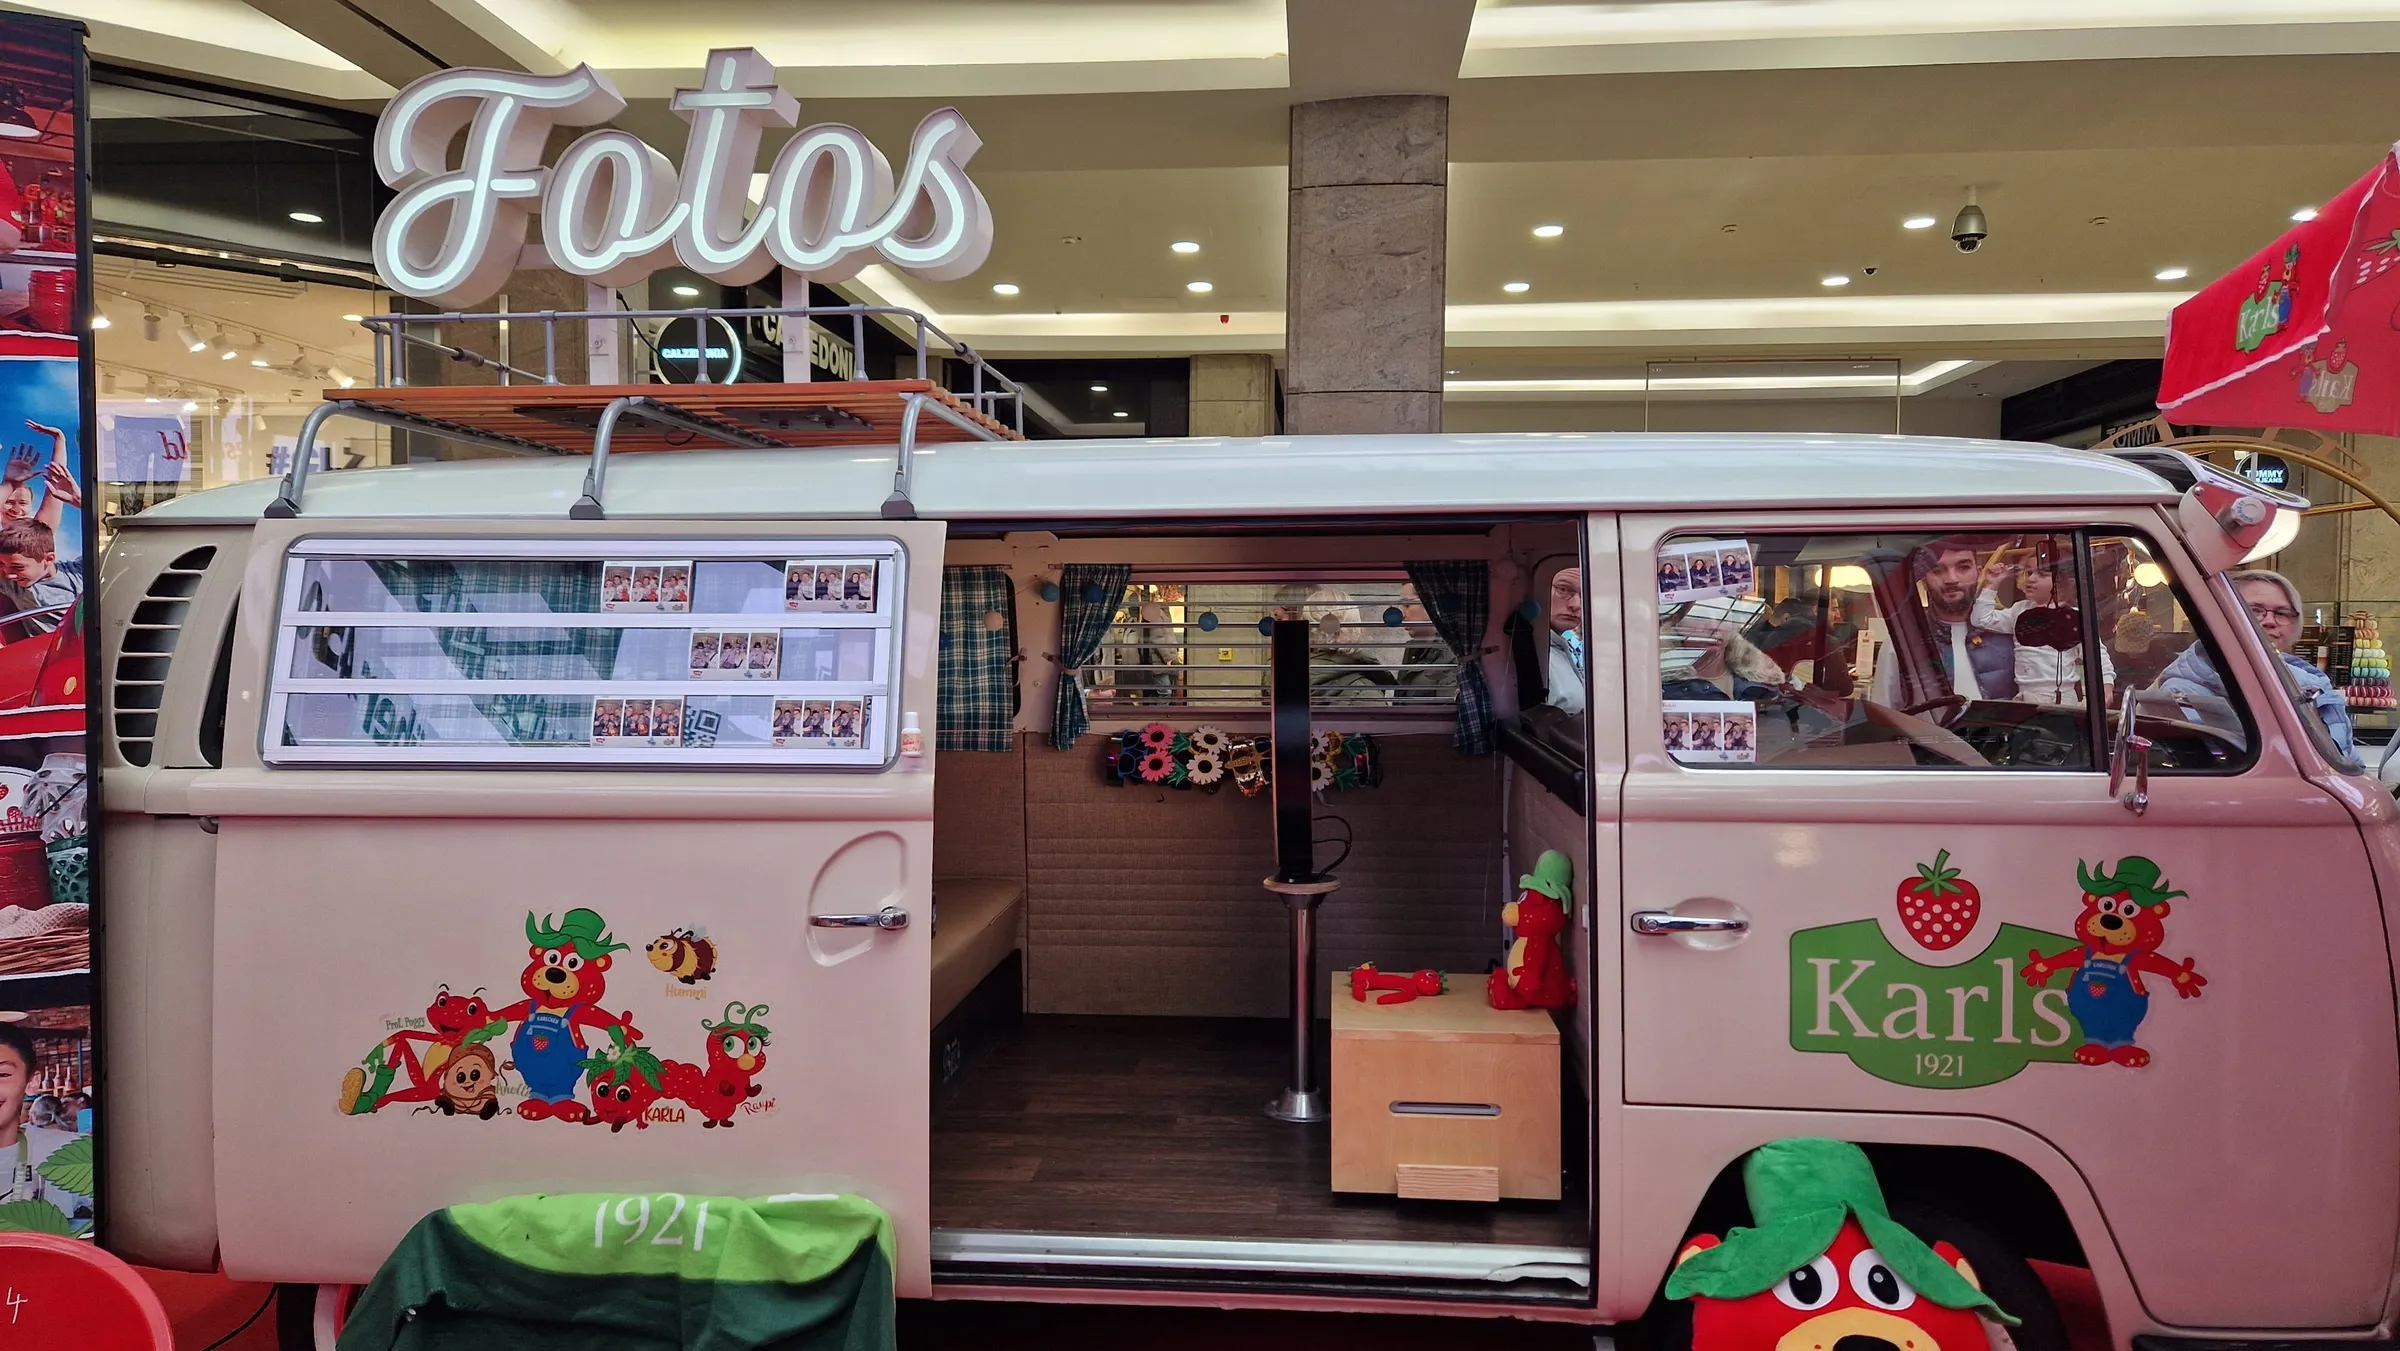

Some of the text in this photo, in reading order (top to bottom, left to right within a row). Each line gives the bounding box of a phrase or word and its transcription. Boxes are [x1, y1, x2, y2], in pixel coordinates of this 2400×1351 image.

[372, 46, 994, 308] Fotos
[2238, 296, 2280, 342] Karls
[762, 305, 858, 382] CAEDONI
[665, 983, 708, 998] Hummi
[1807, 957, 2072, 1047] Karls
[385, 1017, 404, 1031] Prof.
[1915, 1053, 1964, 1077] 1921
[644, 1107, 685, 1123] KARLA
[741, 1097, 777, 1115] Raupi
[594, 1193, 710, 1252] 1921
[6, 1286, 29, 1324] 4
